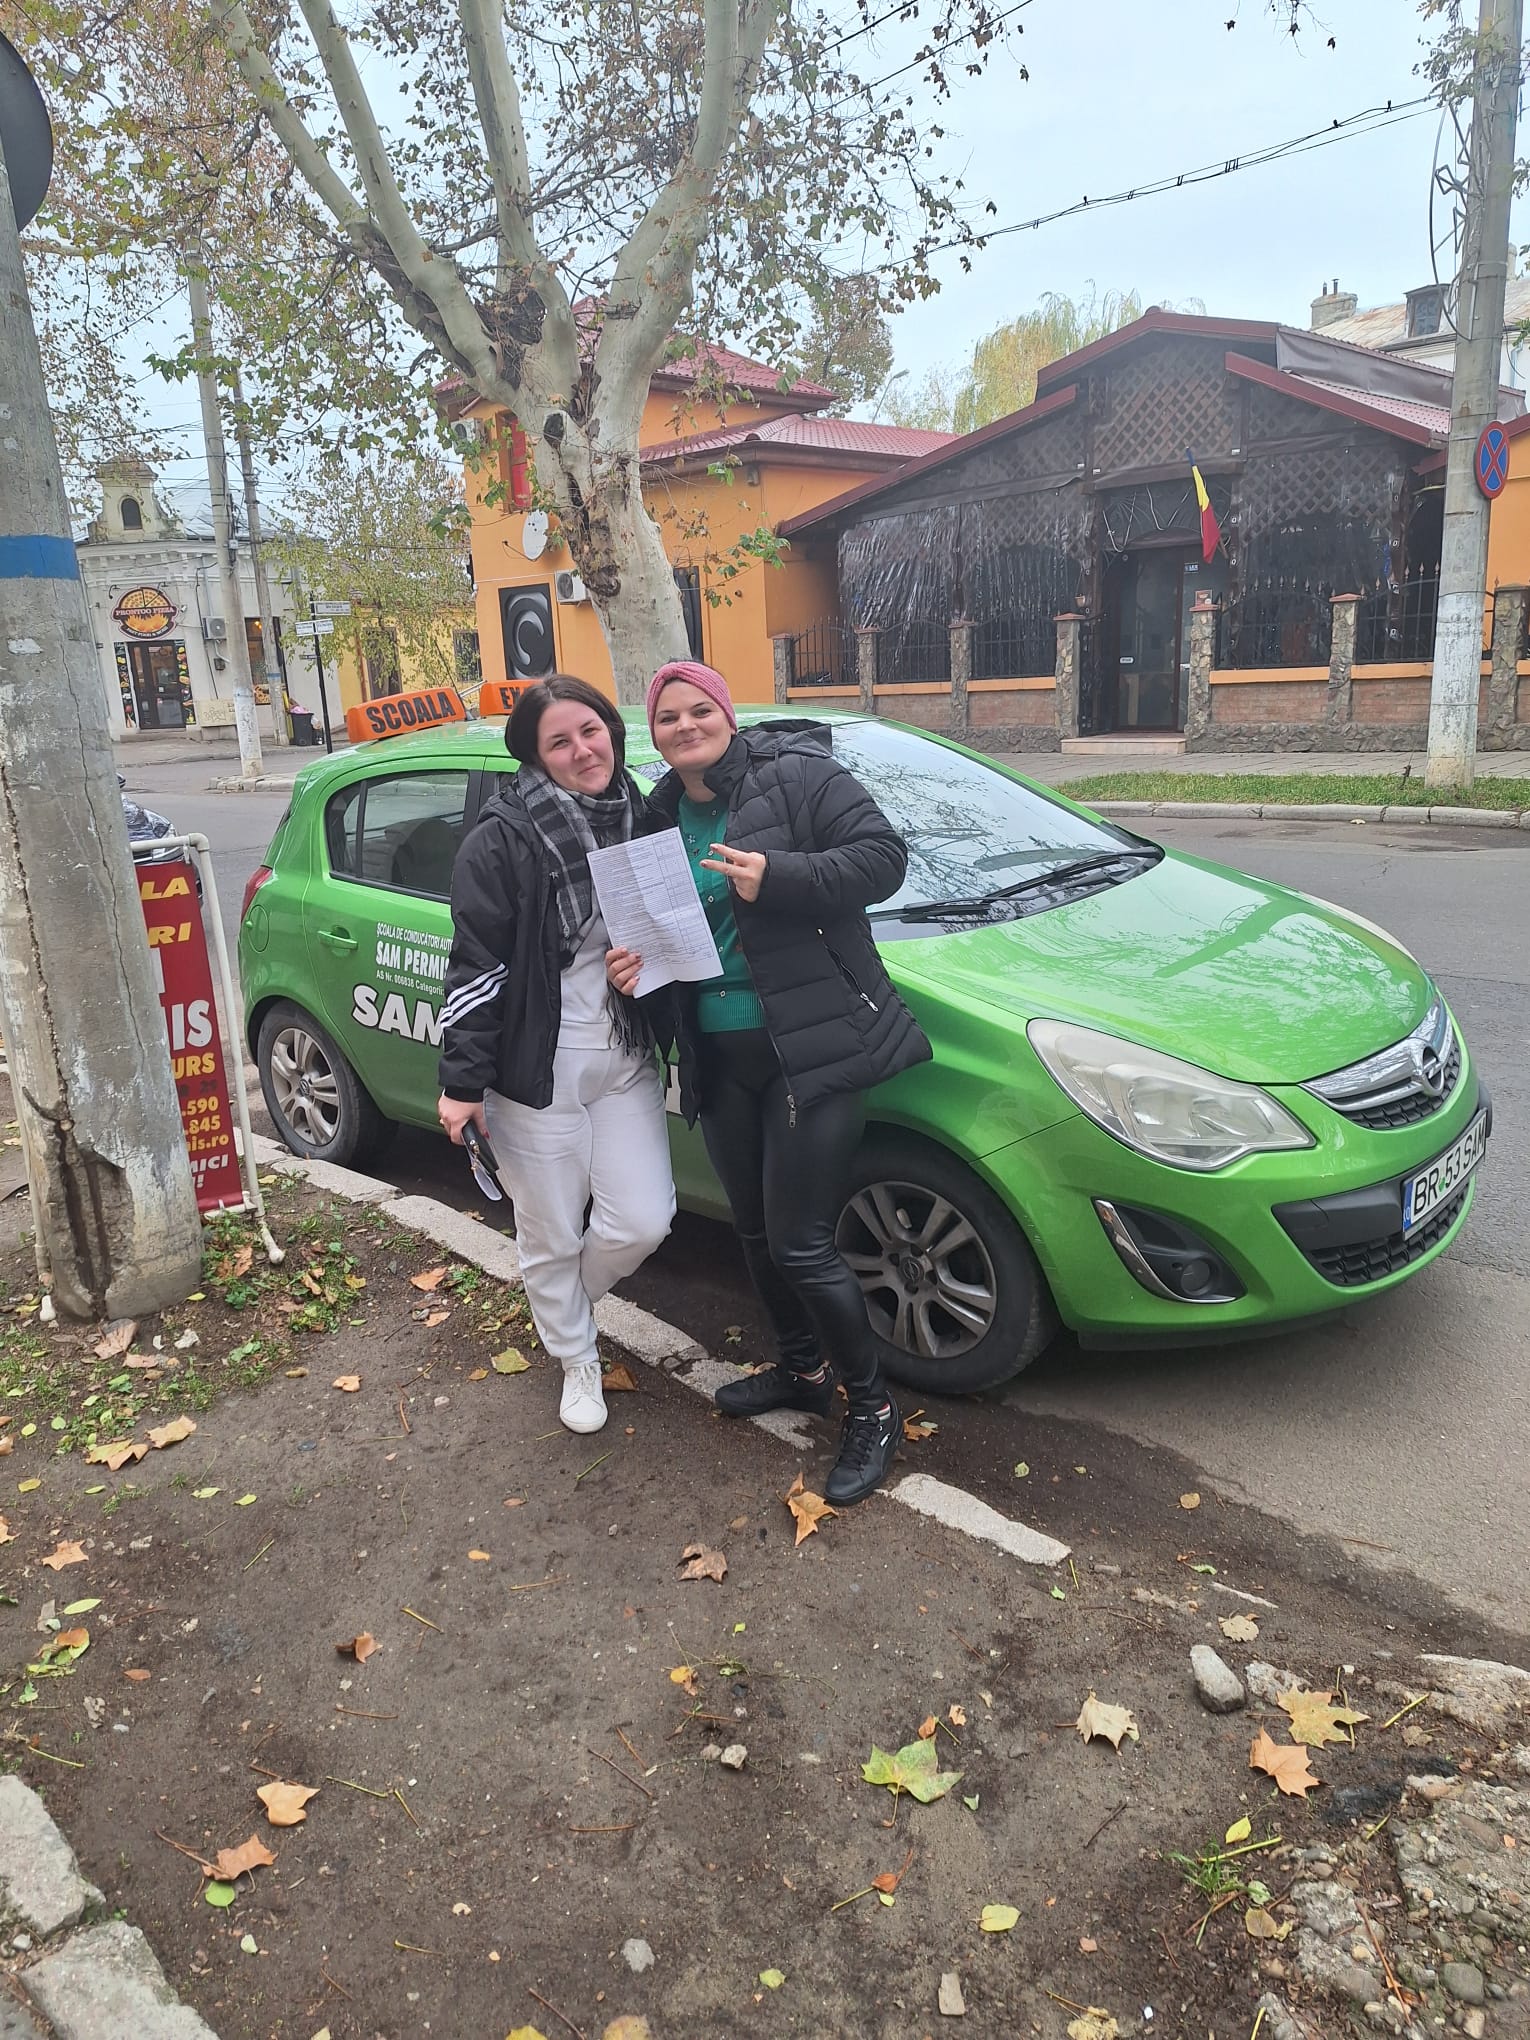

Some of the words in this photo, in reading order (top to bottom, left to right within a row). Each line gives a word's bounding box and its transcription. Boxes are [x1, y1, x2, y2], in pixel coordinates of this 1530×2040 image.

[153, 606, 175, 614] PIZZA
[499, 686, 522, 710] EX
[366, 691, 456, 733] SCOALA
[140, 876, 191, 901] LA
[148, 921, 192, 947] RI
[395, 927, 404, 940] DE
[440, 937, 454, 952] AUT
[376, 940, 401, 970] SAM
[171, 999, 213, 1051] IS
[351, 983, 454, 1047] SAM
[171, 1052, 216, 1080] URS
[181, 1095, 219, 1117] .590
[183, 1114, 221, 1136] .845
[188, 1134, 229, 1151] is.ro
[1414, 1167, 1440, 1216] BR
[1445, 1146, 1461, 1189] 53
[1463, 1116, 1486, 1170] SAM
